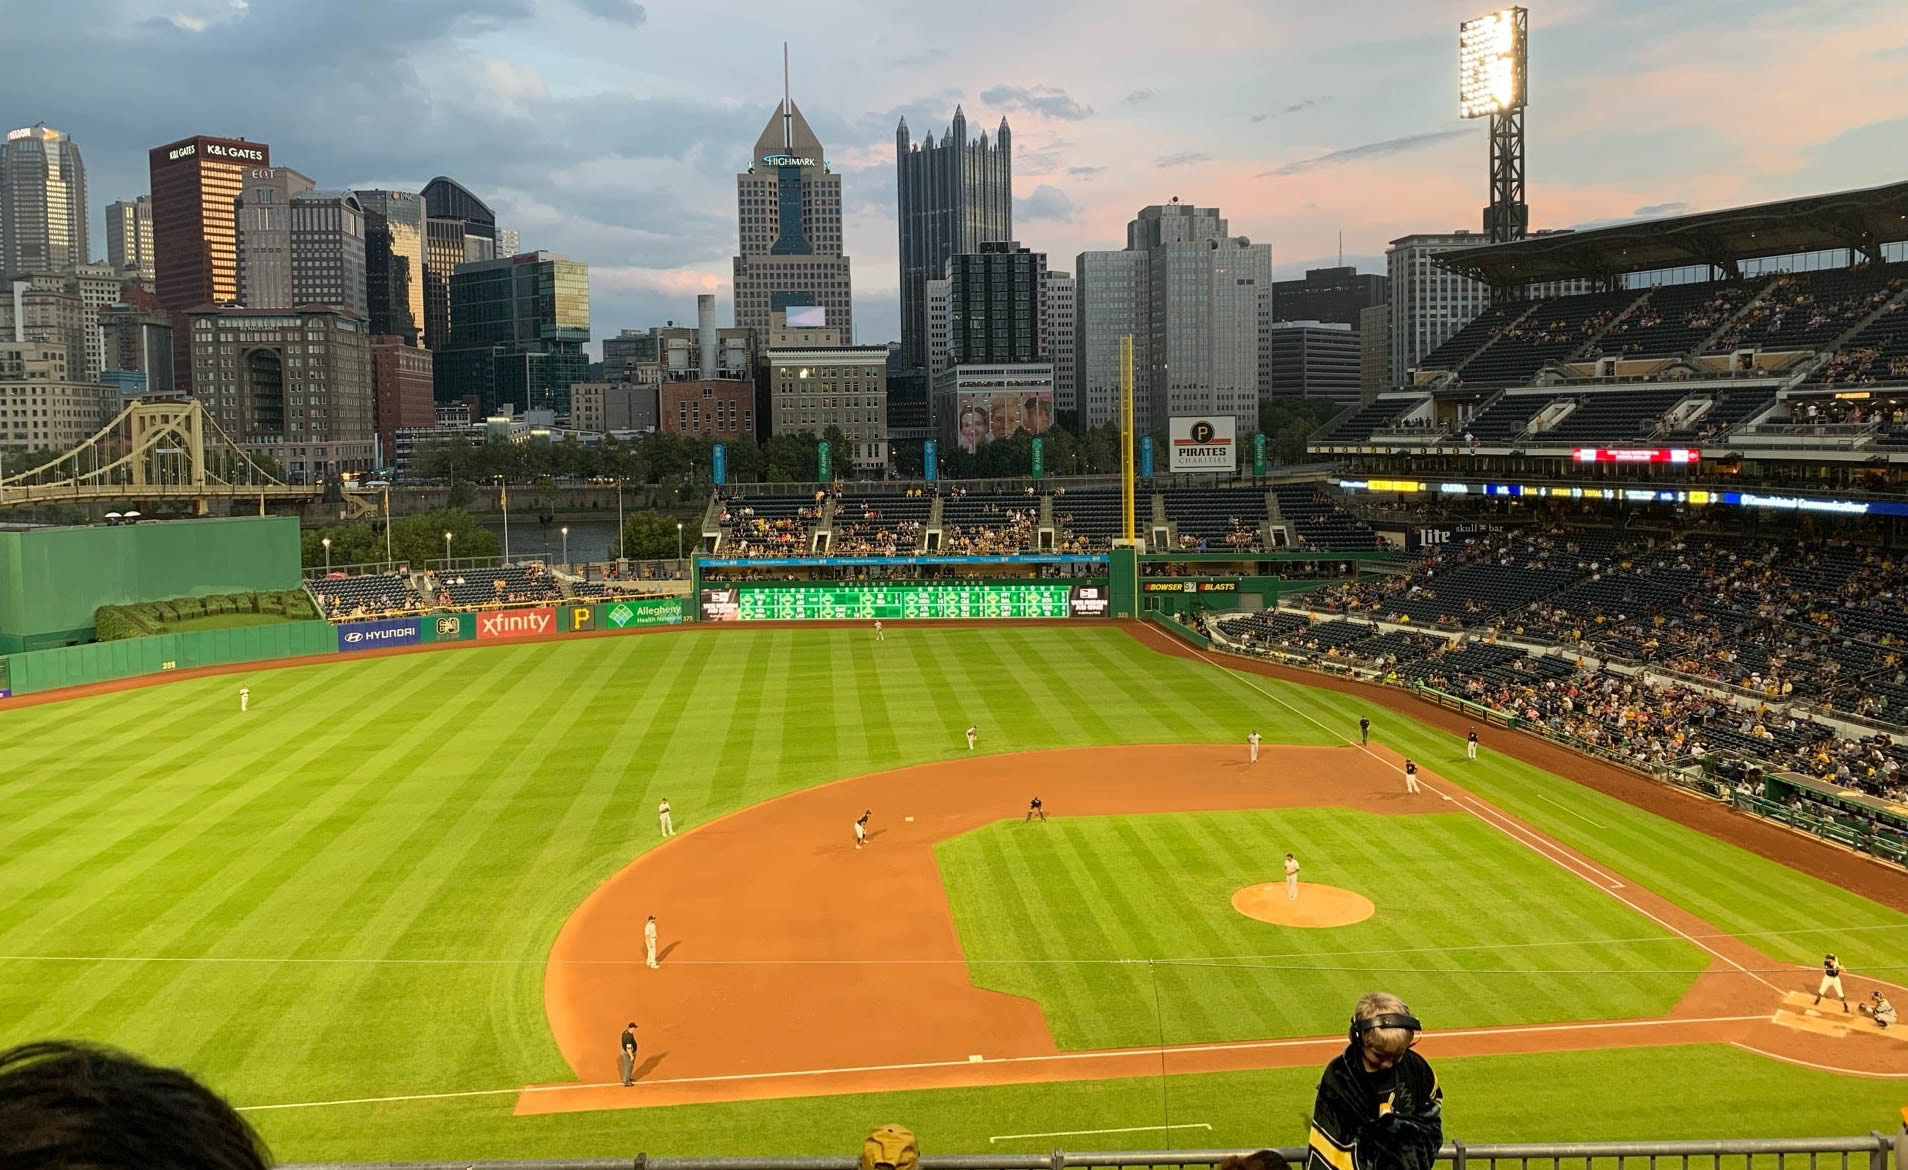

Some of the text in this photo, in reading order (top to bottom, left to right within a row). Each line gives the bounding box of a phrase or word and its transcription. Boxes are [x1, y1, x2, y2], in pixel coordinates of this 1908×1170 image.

[178, 144, 196, 157] GATES
[207, 144, 263, 161] K&L GATES
[768, 157, 815, 167] HIGHMARK
[1198, 426, 1208, 441] P
[1178, 447, 1226, 457] PIRATES
[1178, 456, 1226, 464] CHARITIES
[1583, 489, 1603, 498] TOTAL
[1603, 488, 1614, 499] 16
[1678, 490, 1686, 502] 5
[1710, 491, 1718, 503] 3
[1455, 523, 1503, 533] skull bar
[1420, 528, 1451, 546] lite
[1150, 582, 1235, 591] BOWSER 57 BLASTS
[637, 605, 681, 616] Allegheny
[482, 612, 551, 636] xfinity
[574, 607, 590, 629] P
[365, 627, 416, 641] HYUNDAI
